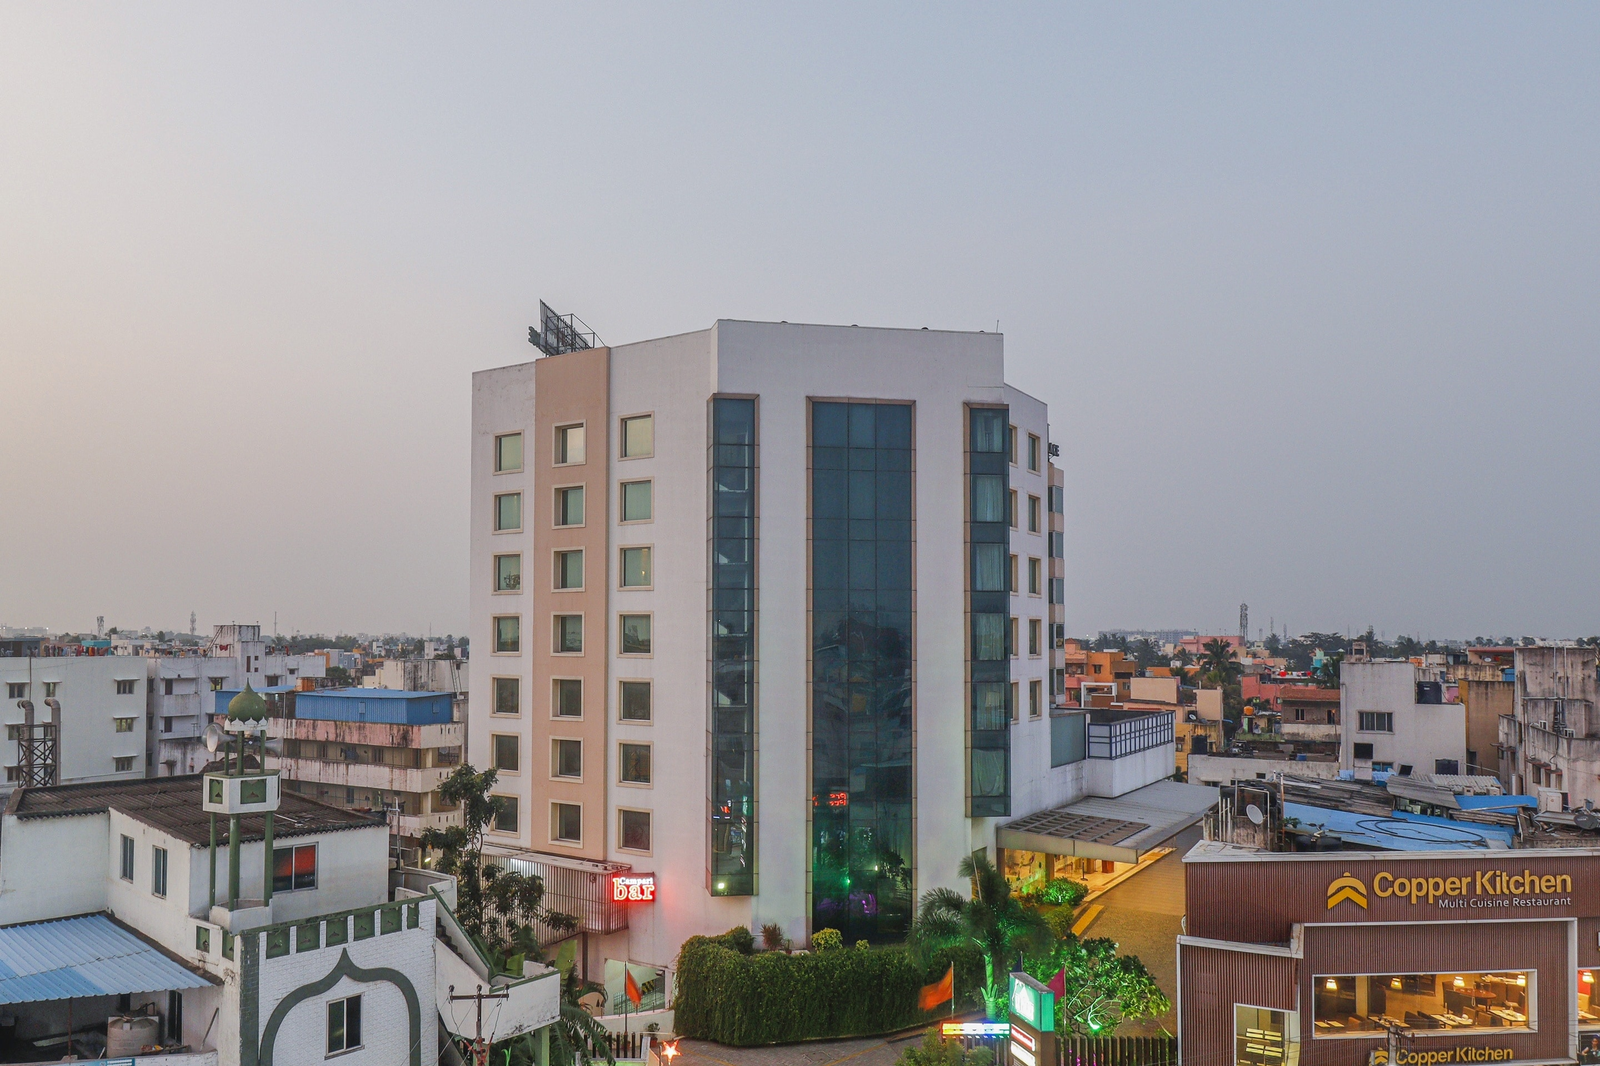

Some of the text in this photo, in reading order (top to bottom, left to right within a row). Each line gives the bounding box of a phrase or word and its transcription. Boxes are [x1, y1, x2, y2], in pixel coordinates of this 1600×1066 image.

[613, 878, 655, 900] bar
[1373, 869, 1572, 904] Copper Kitchen
[1438, 897, 1571, 908] Multi Cuisine Restaurant
[1396, 1046, 1513, 1066] Copper Kitchen
